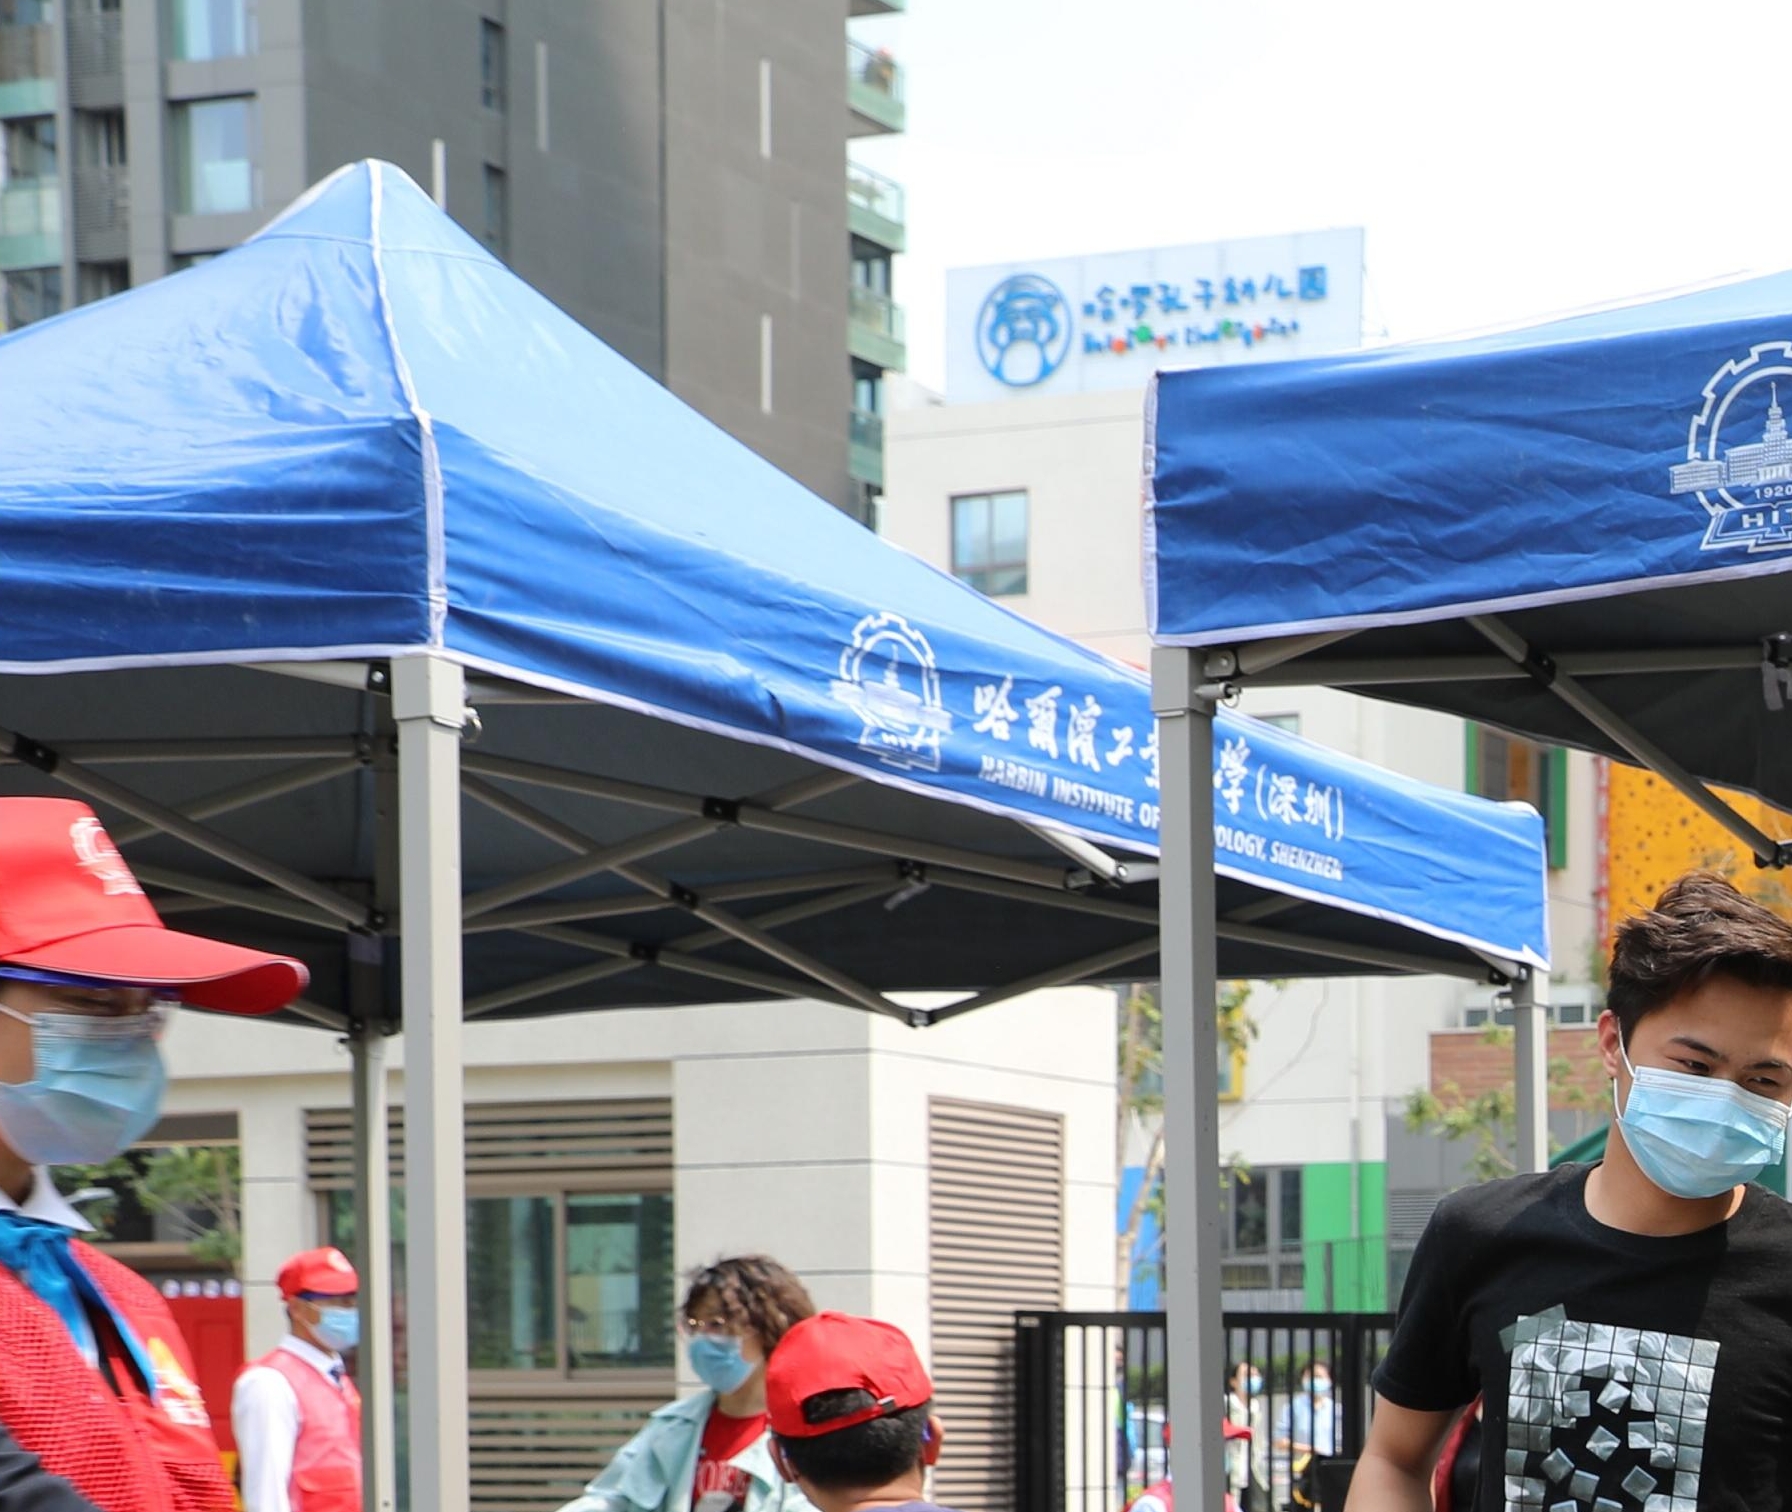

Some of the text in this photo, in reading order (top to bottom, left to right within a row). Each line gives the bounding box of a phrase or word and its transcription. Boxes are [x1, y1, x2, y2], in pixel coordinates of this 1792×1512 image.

[979, 754, 1048, 798] HARBIN
[1053, 776, 1134, 823] INSTITUTE
[1139, 802, 1161, 830] OF
[1269, 841, 1343, 881] SHENZHEN
